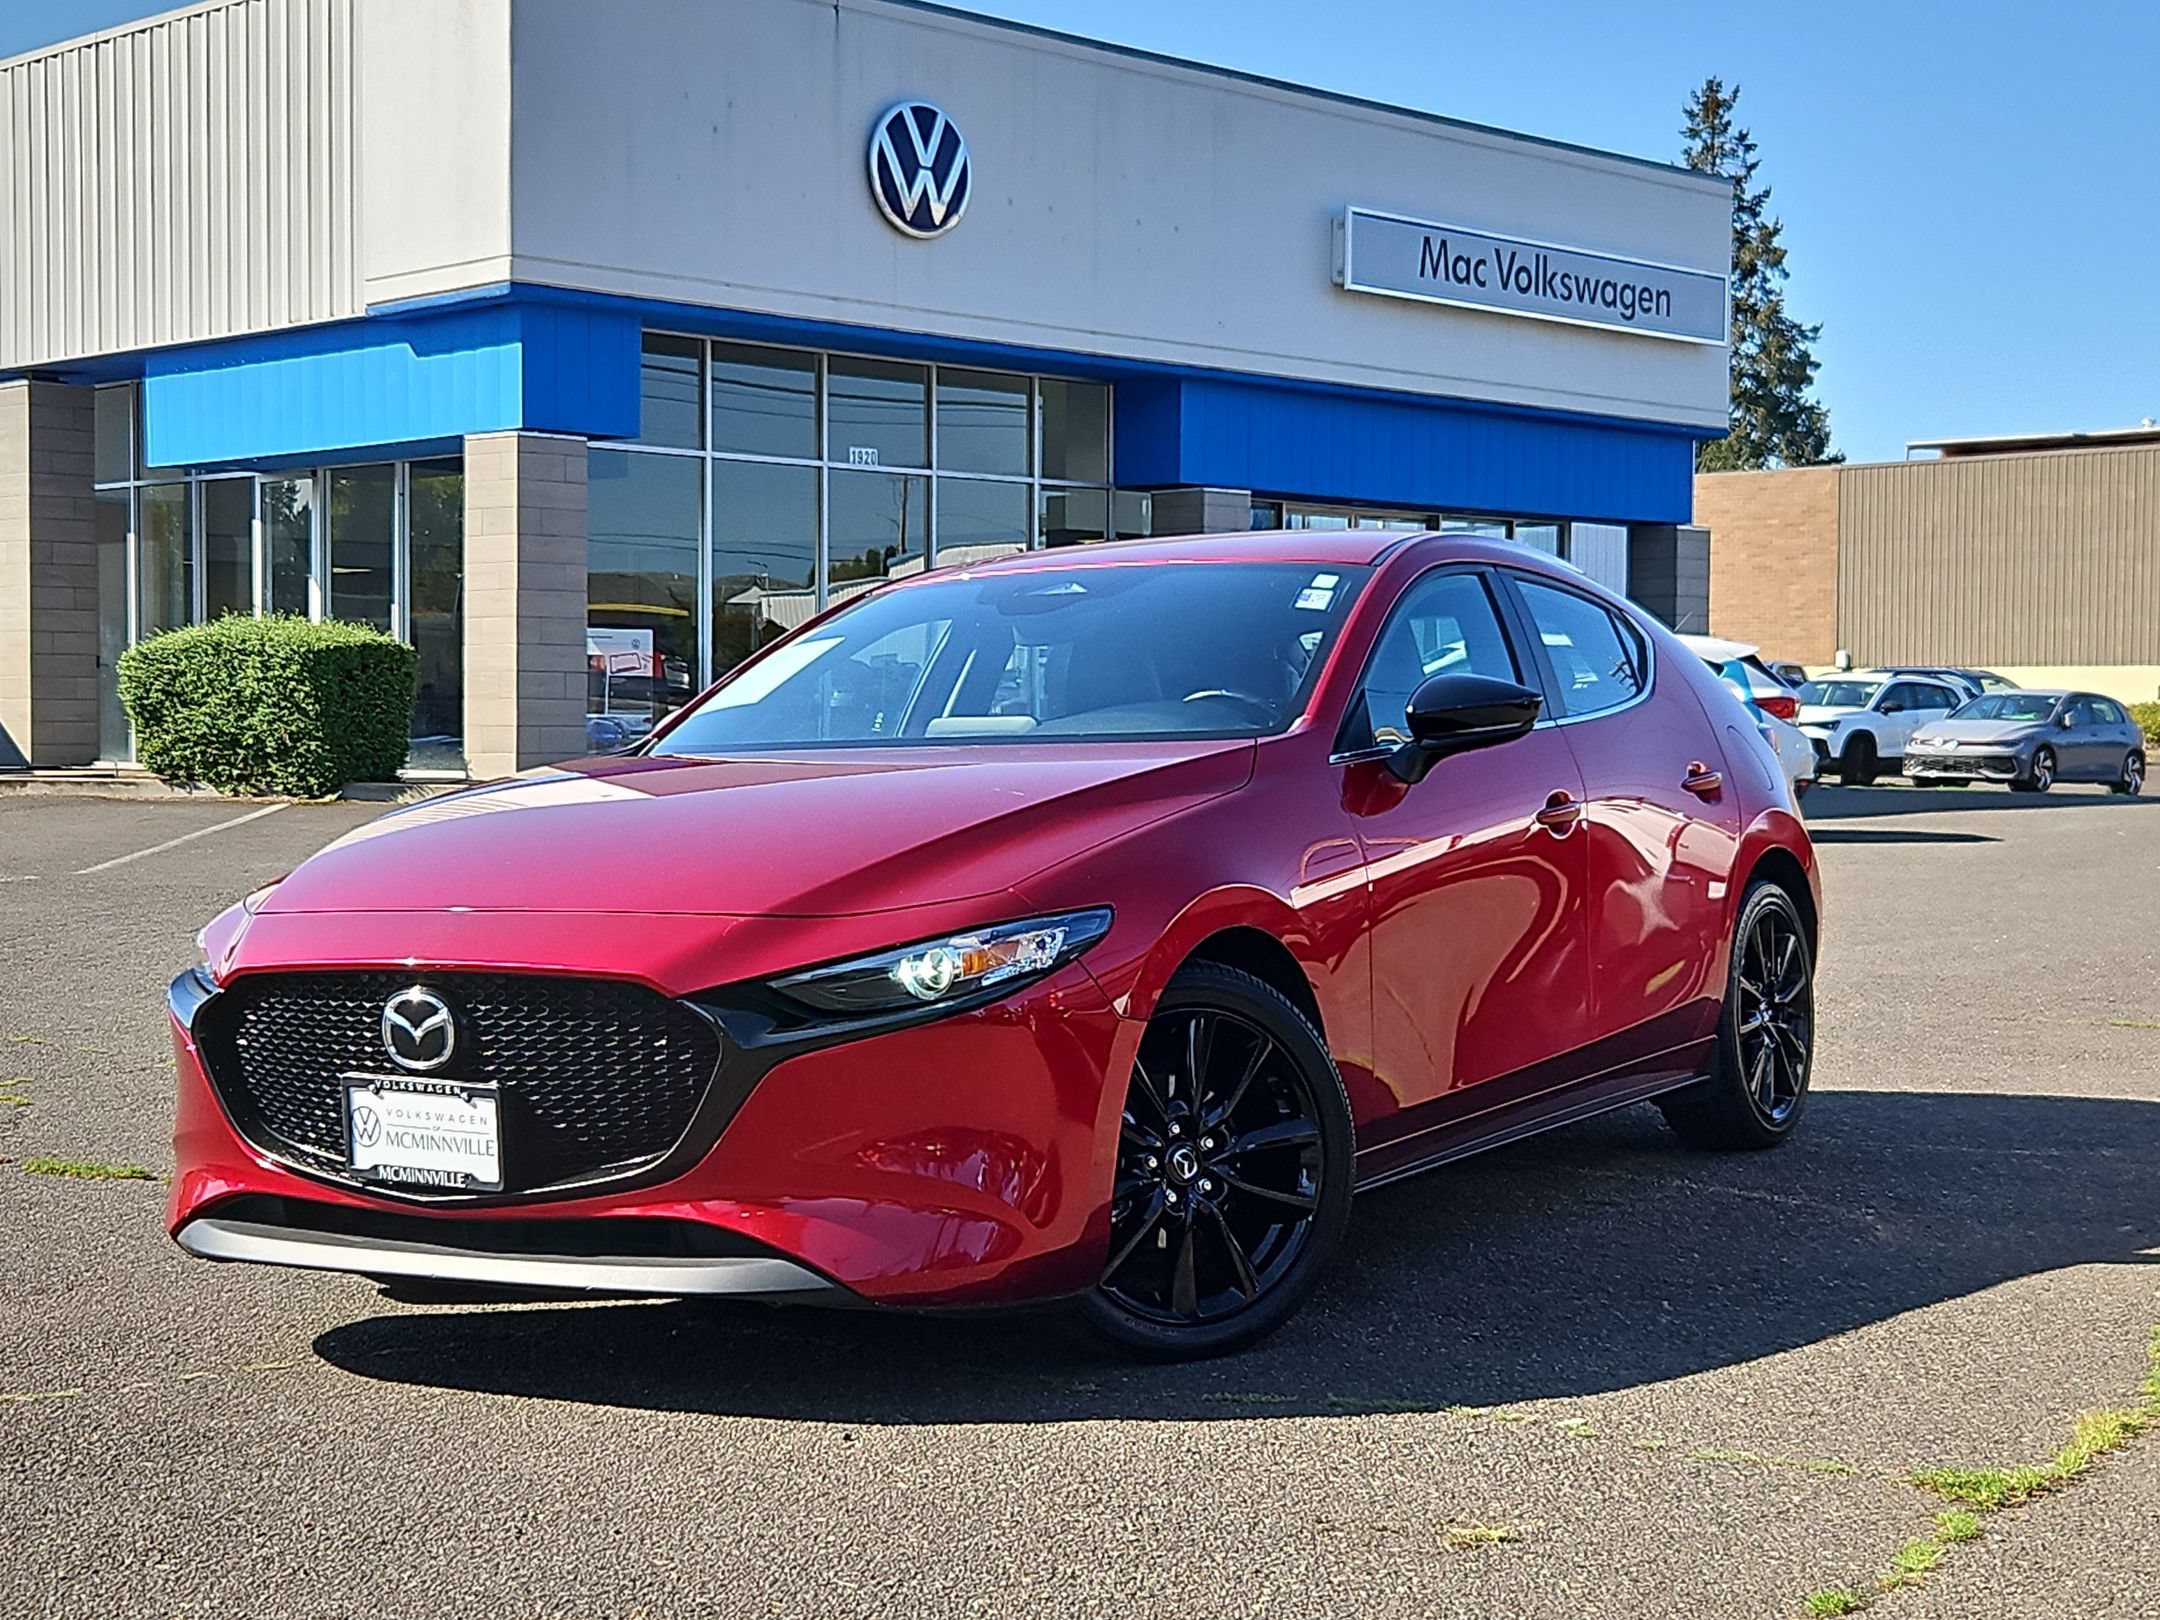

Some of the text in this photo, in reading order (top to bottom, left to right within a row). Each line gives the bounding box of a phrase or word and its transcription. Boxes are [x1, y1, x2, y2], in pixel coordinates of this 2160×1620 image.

[1419, 235, 1671, 321] Mac Volkswagen
[851, 450, 878, 466] 1920
[375, 1079, 461, 1094] VOLKSWAGEN
[386, 1108, 488, 1126] VOLKSWAGEN
[386, 1130, 495, 1157] MCMINNVILLE
[378, 1164, 467, 1188] MCMINNVILLE
